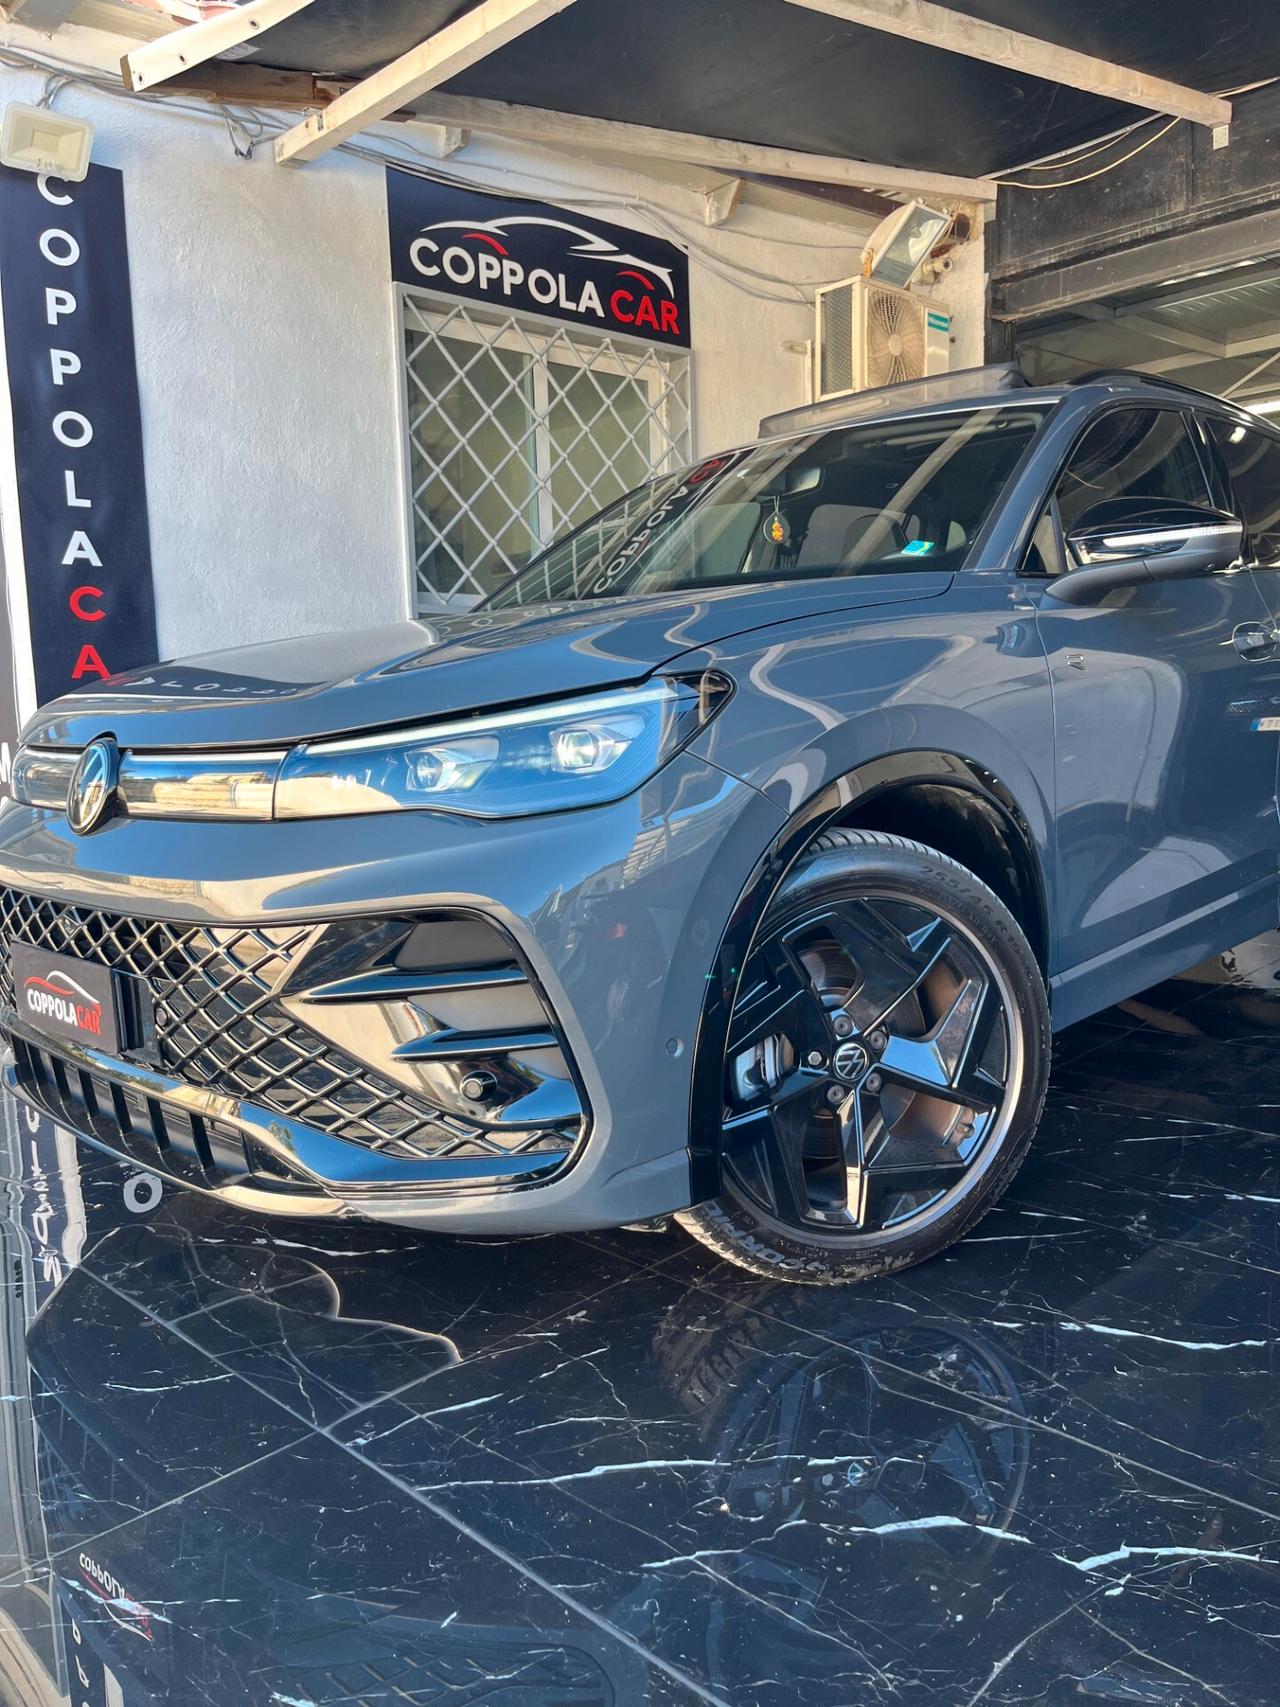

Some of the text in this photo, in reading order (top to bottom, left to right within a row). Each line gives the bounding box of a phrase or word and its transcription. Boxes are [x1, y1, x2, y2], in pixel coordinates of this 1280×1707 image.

[409, 237, 680, 335] COPPOLA CAR
[27, 988, 103, 1036] COPPOLA CAR
